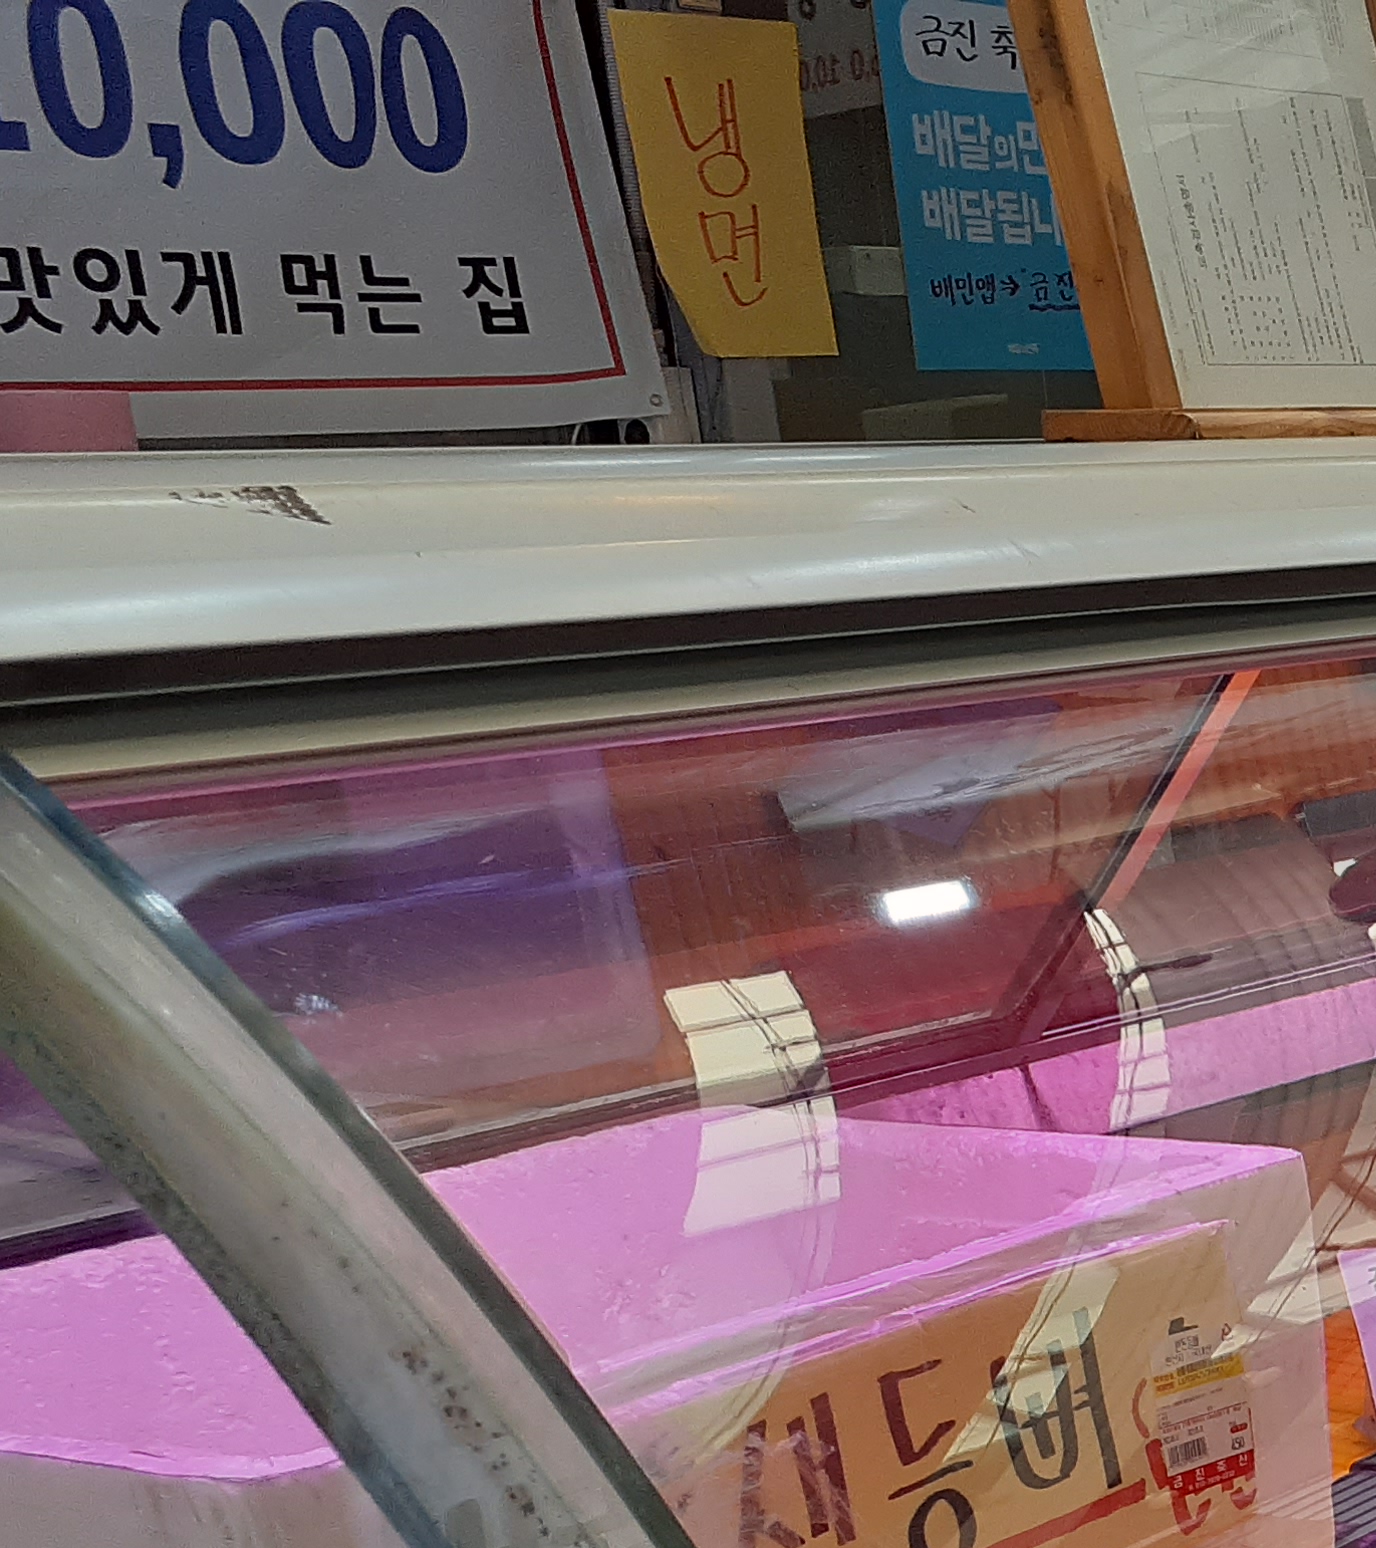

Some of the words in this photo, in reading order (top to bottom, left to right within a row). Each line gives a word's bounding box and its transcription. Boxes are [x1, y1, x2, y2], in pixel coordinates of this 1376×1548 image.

[915, 15, 979, 62] 금진
[665, 76, 768, 308] 냉면
[0, 246, 243, 337] 맛있게
[280, 252, 422, 336] 먹는
[457, 255, 531, 336] 집
[930, 271, 997, 306] 배민앱
